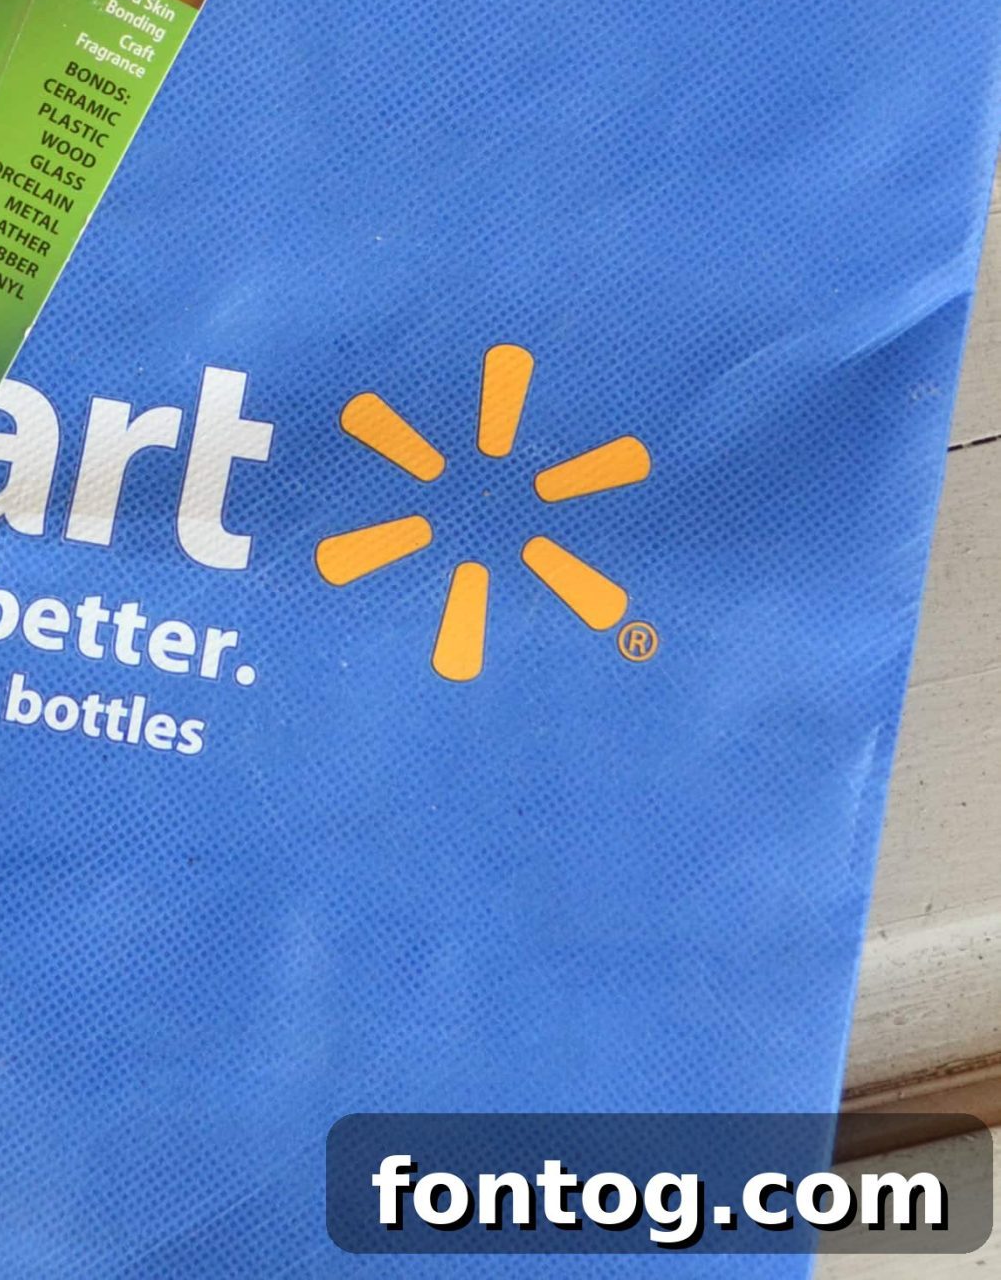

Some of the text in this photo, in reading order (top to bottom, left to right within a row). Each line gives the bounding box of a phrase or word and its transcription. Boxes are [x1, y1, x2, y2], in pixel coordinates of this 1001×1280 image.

[106, 0, 166, 42] Bonding
[75, 32, 146, 78] Fragrance
[119, 35, 156, 62] Craft
[43, 78, 122, 127] CERAMIC
[64, 61, 131, 105] BONDS:
[38, 102, 110, 149] PLASTIC
[40, 130, 96, 169] WOOD
[30, 154, 86, 192] GLASS
[5, 196, 59, 235] METAL
[5, 673, 206, 755] bottles
